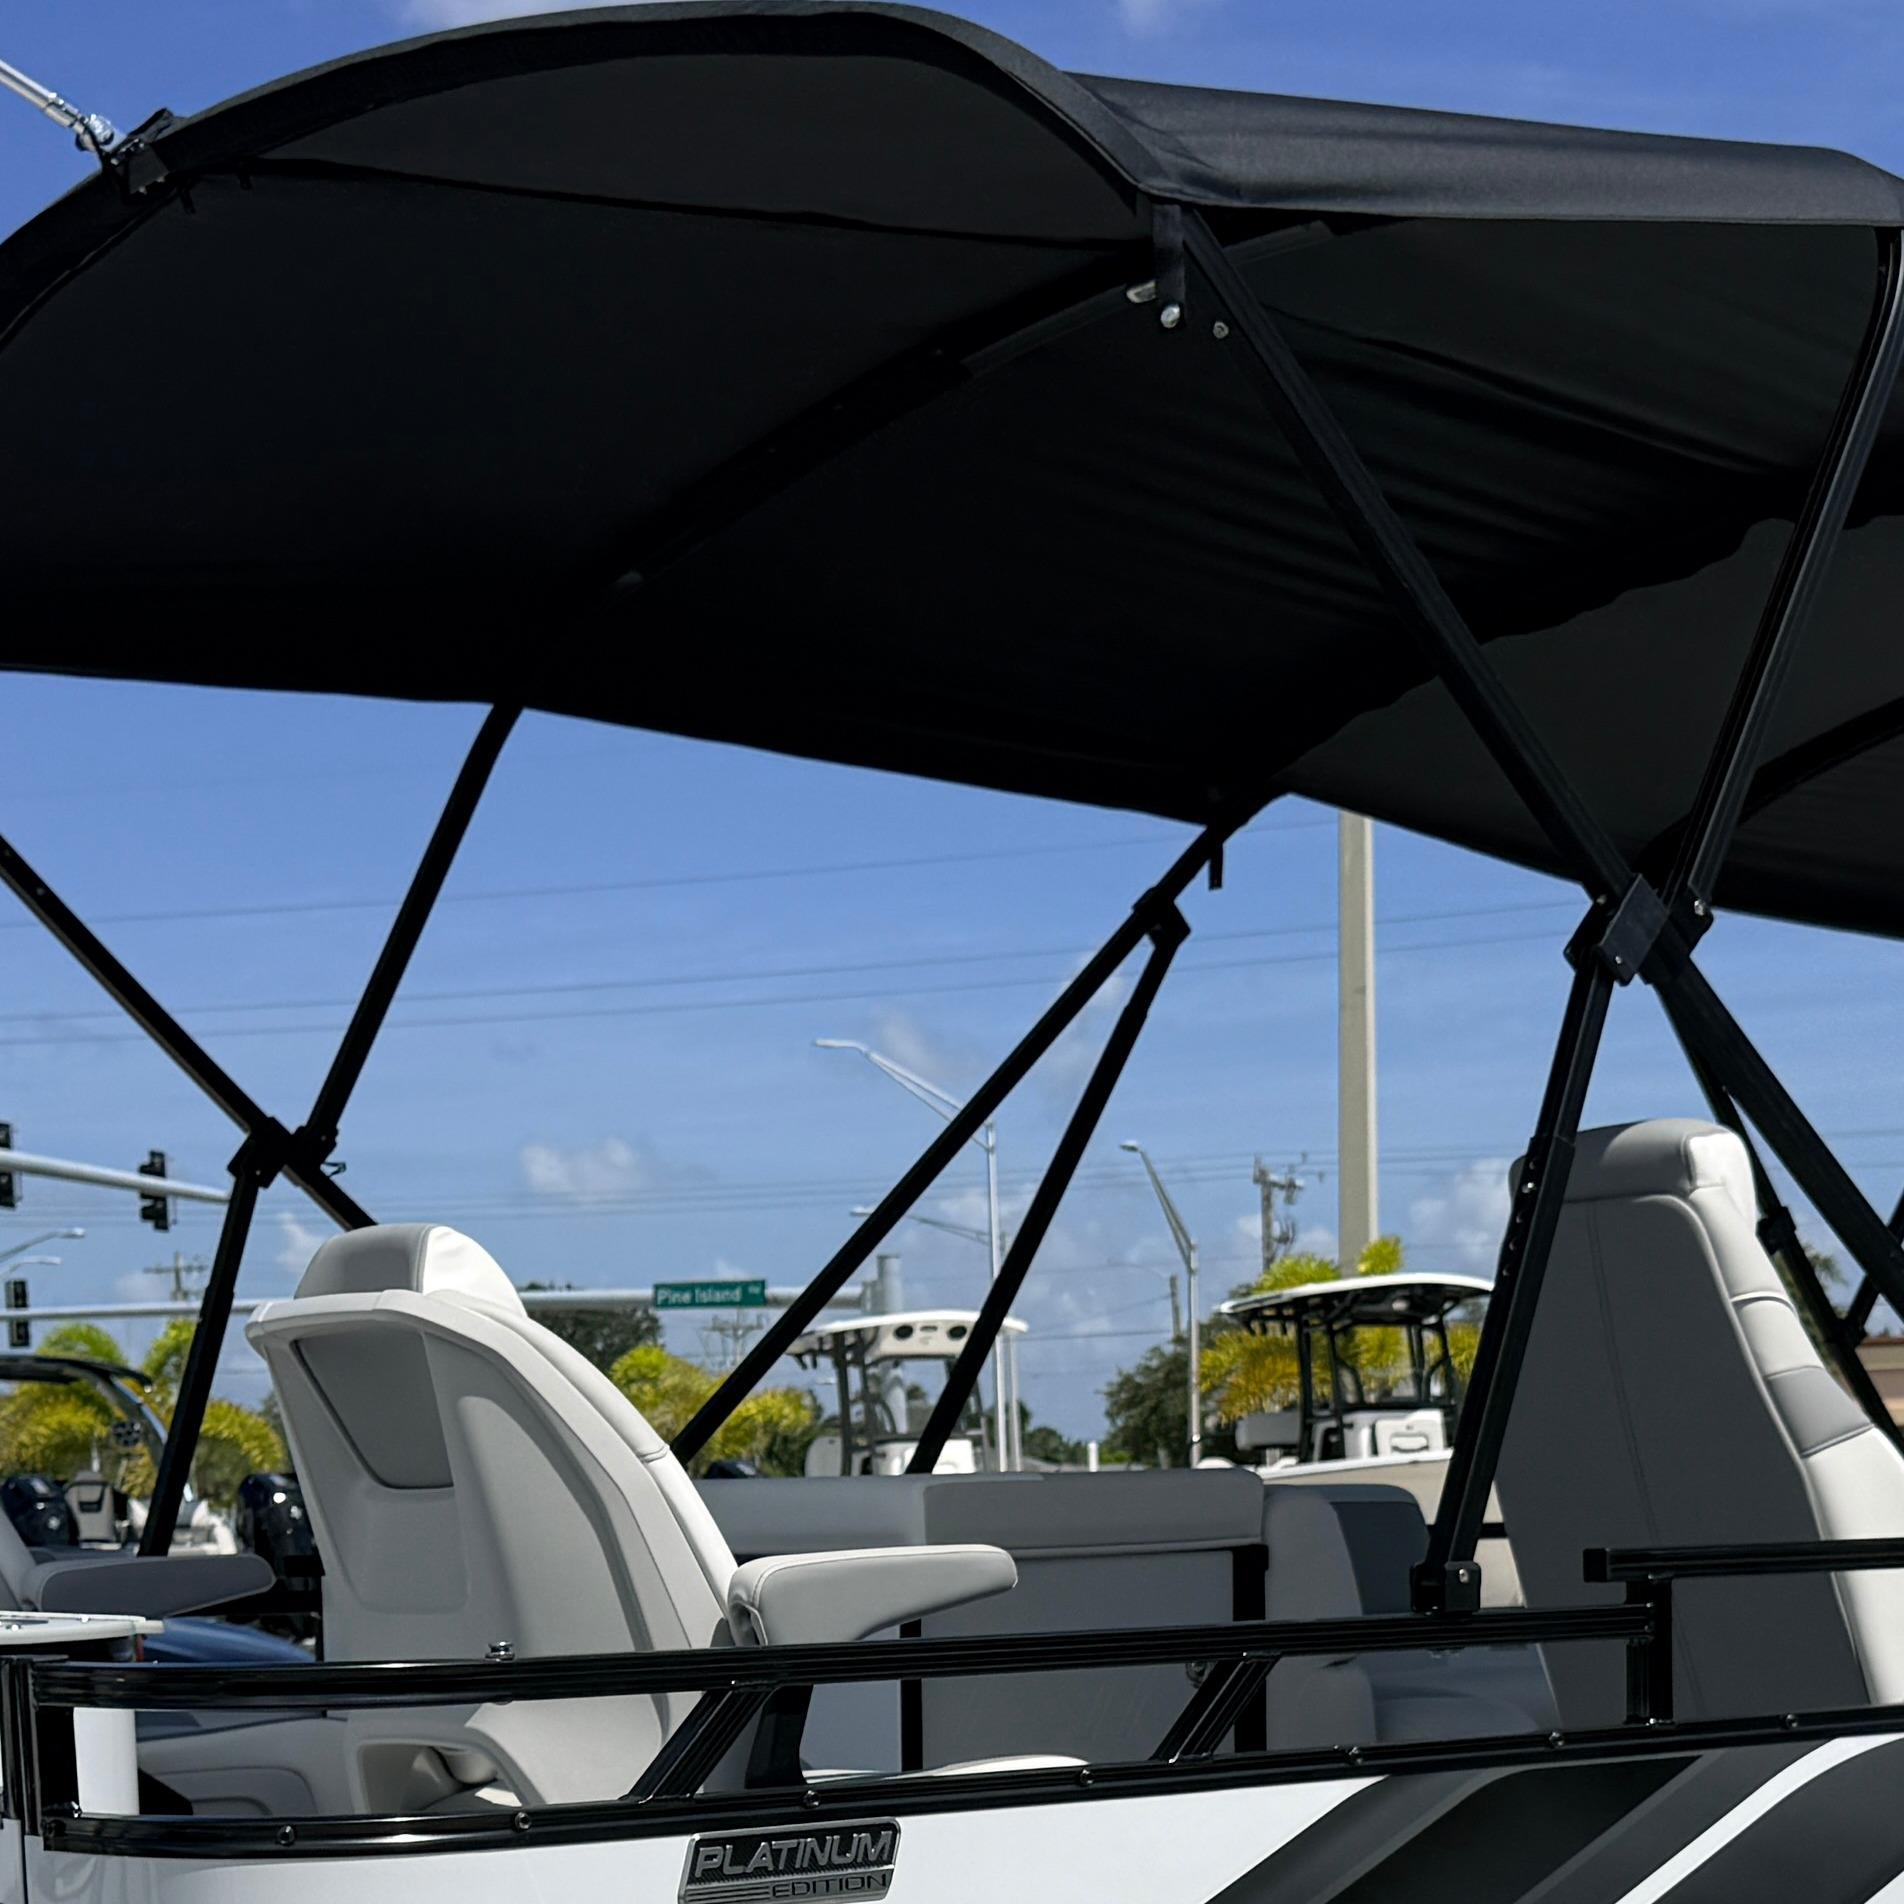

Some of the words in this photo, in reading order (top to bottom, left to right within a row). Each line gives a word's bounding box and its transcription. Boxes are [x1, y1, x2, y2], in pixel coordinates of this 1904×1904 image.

[656, 1287, 692, 1306] Pine
[694, 1285, 743, 1304] Island
[694, 1831, 892, 1878] PLATINUM
[771, 1874, 887, 1898] EDITION
